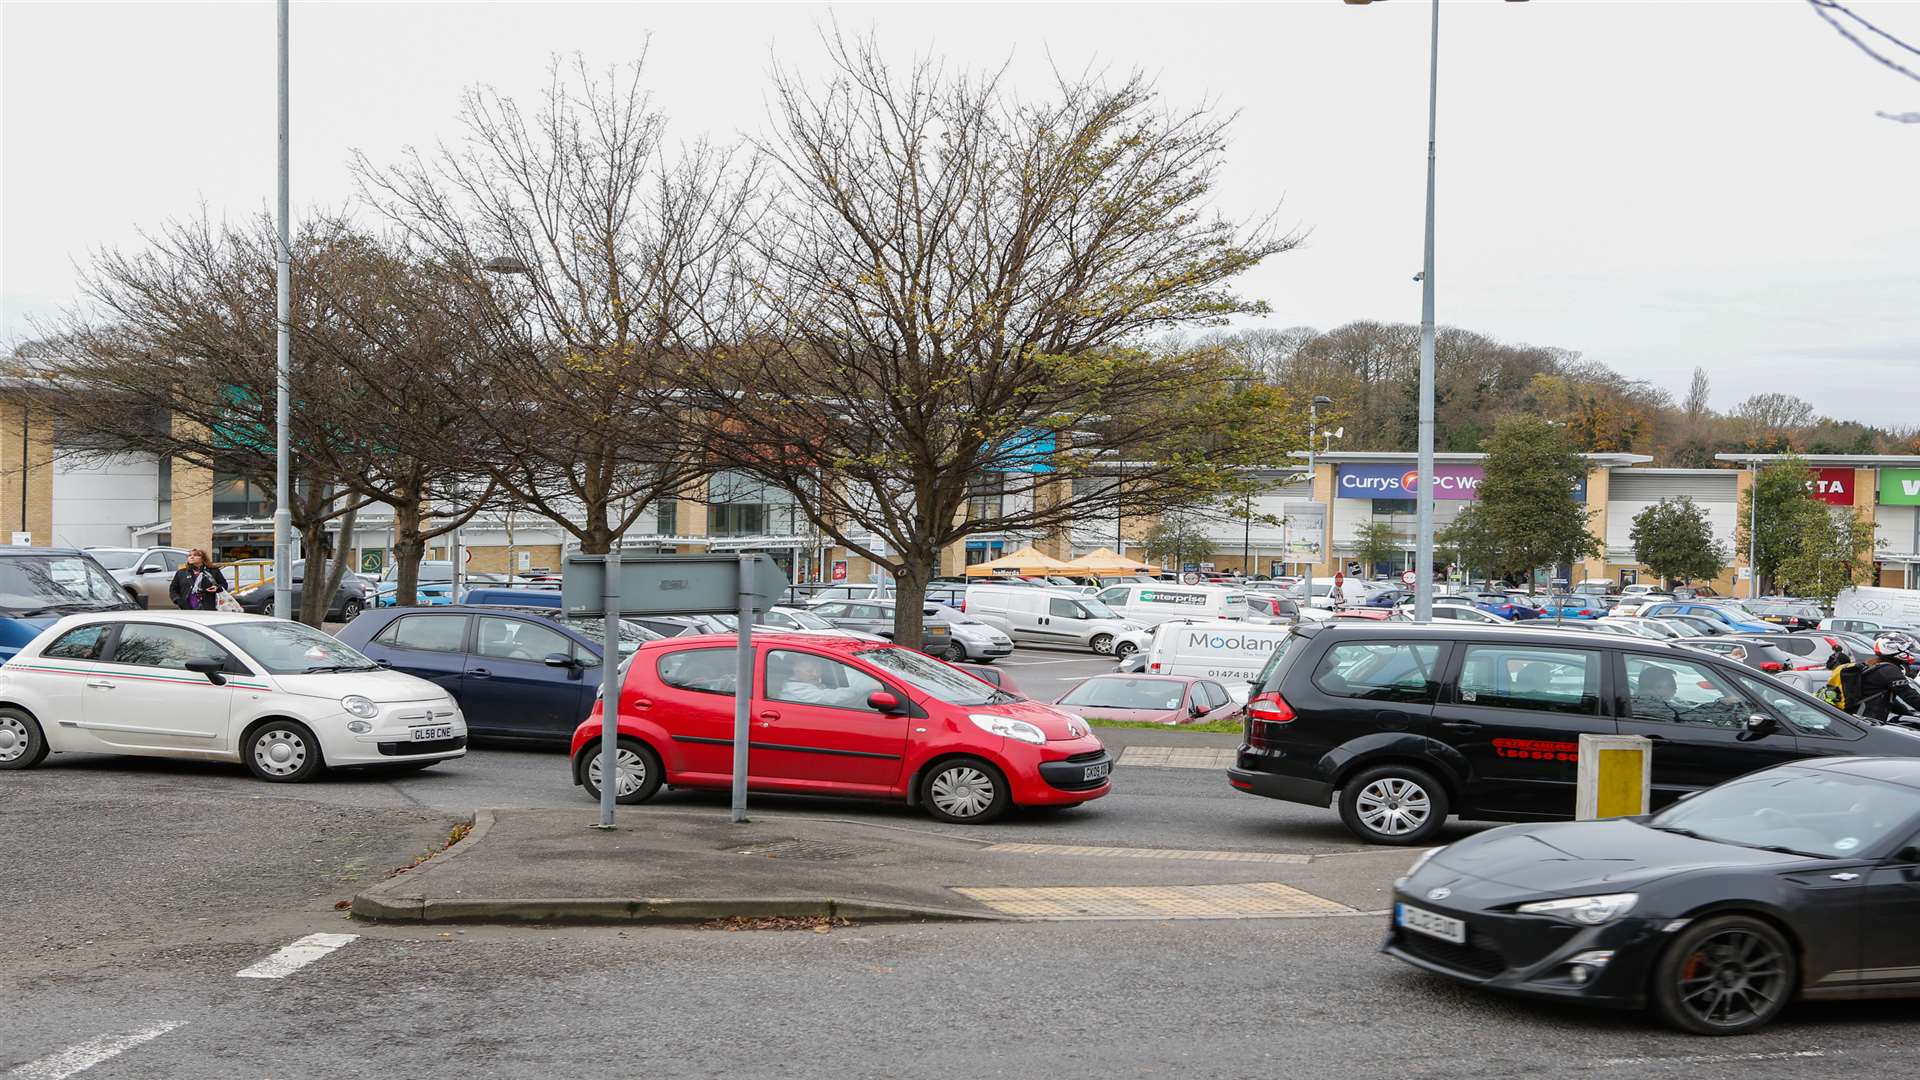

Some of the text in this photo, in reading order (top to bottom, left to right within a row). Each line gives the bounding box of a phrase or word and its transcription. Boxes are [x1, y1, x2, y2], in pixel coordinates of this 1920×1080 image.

[1342, 474, 1400, 491] Currys
[1141, 593, 1205, 604] enterprise
[1208, 669, 1240, 679] 01474
[415, 727, 451, 740] GL58 CNE
